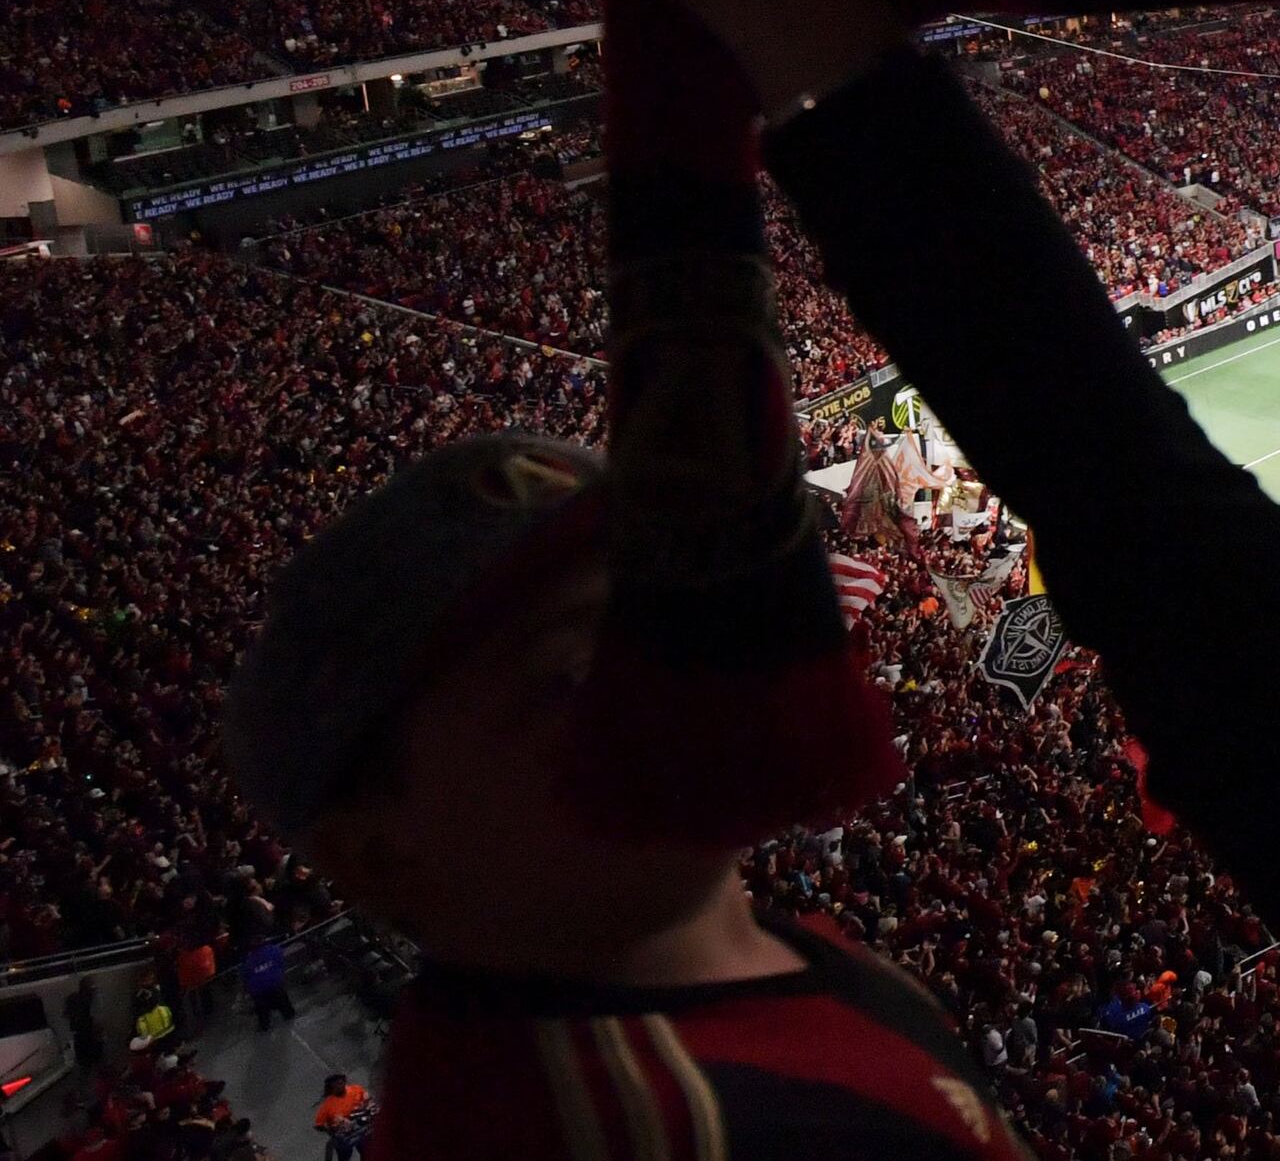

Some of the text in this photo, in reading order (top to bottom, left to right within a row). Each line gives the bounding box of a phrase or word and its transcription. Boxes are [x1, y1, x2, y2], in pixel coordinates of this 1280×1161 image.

[1201, 291, 1227, 317] MLS
[1149, 346, 1186, 369] ORY
[812, 400, 842, 421] OTIE
[843, 386, 871, 408] MOB
